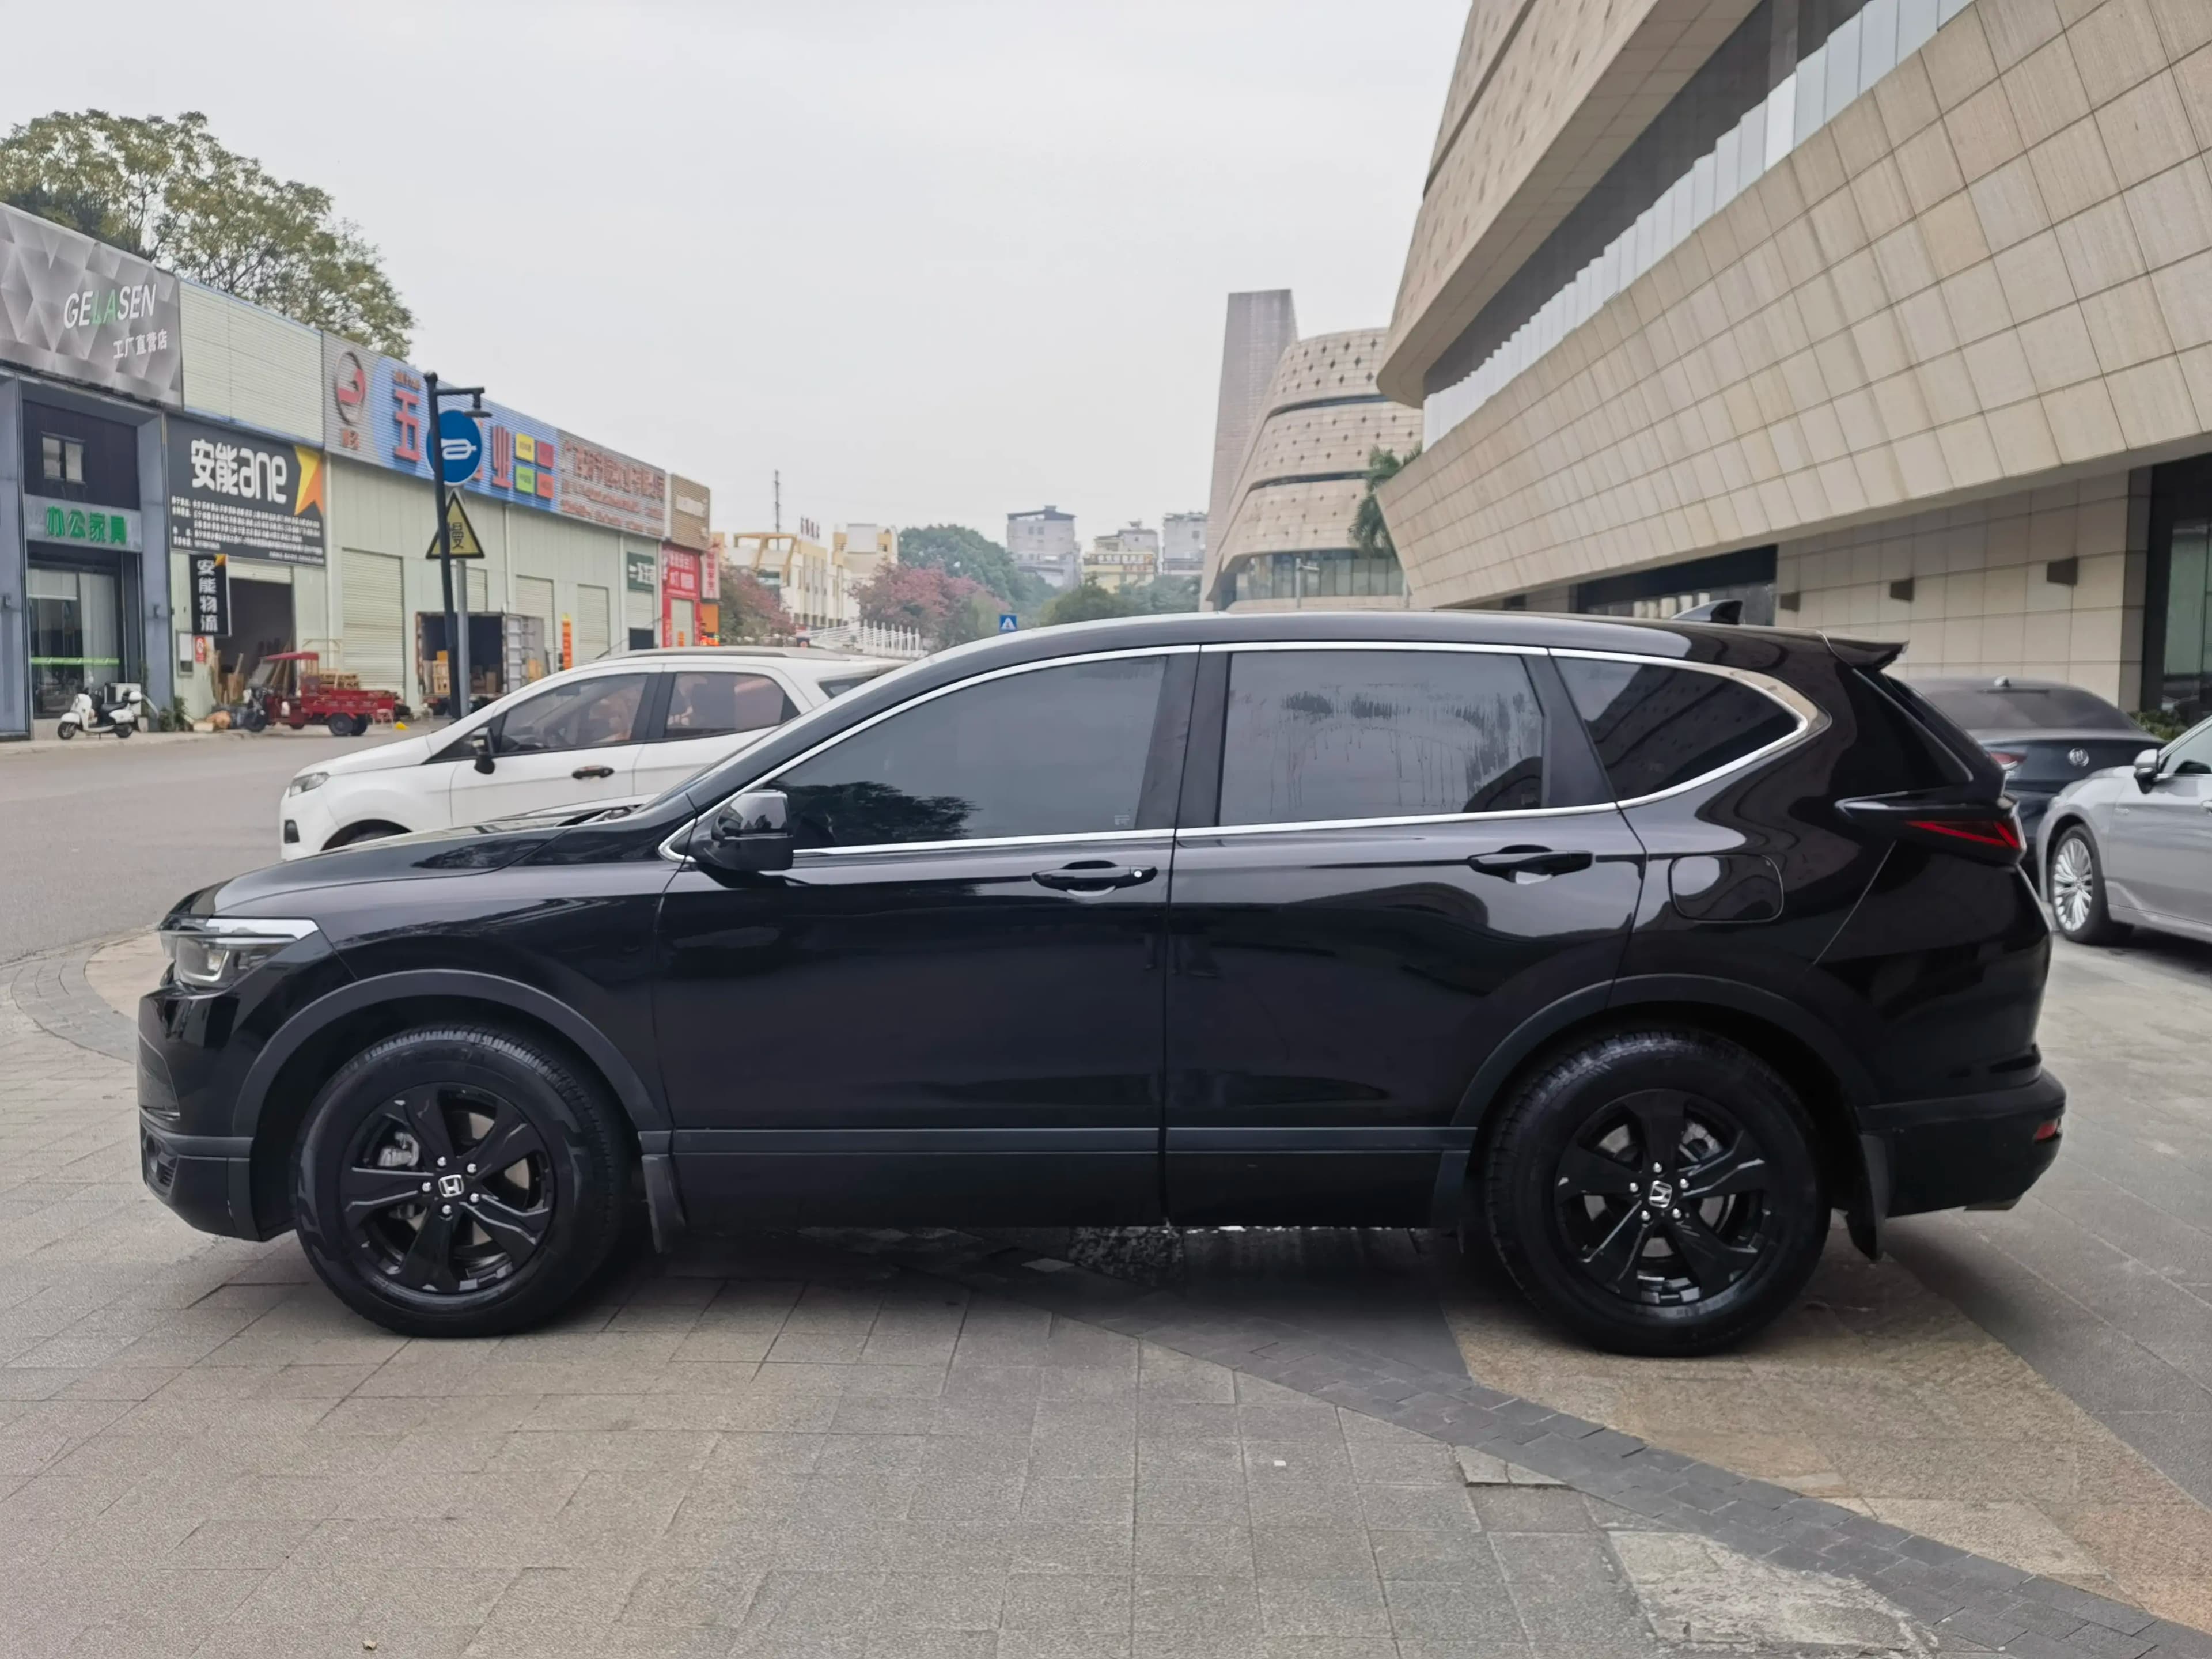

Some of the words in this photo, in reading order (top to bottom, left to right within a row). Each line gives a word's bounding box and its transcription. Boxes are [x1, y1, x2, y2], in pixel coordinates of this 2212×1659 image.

[63, 283, 157, 329] GELASEN
[113, 329, 168, 360] 工厂直营店
[448, 521, 464, 550] 慢
[197, 559, 218, 632] 安能物流
